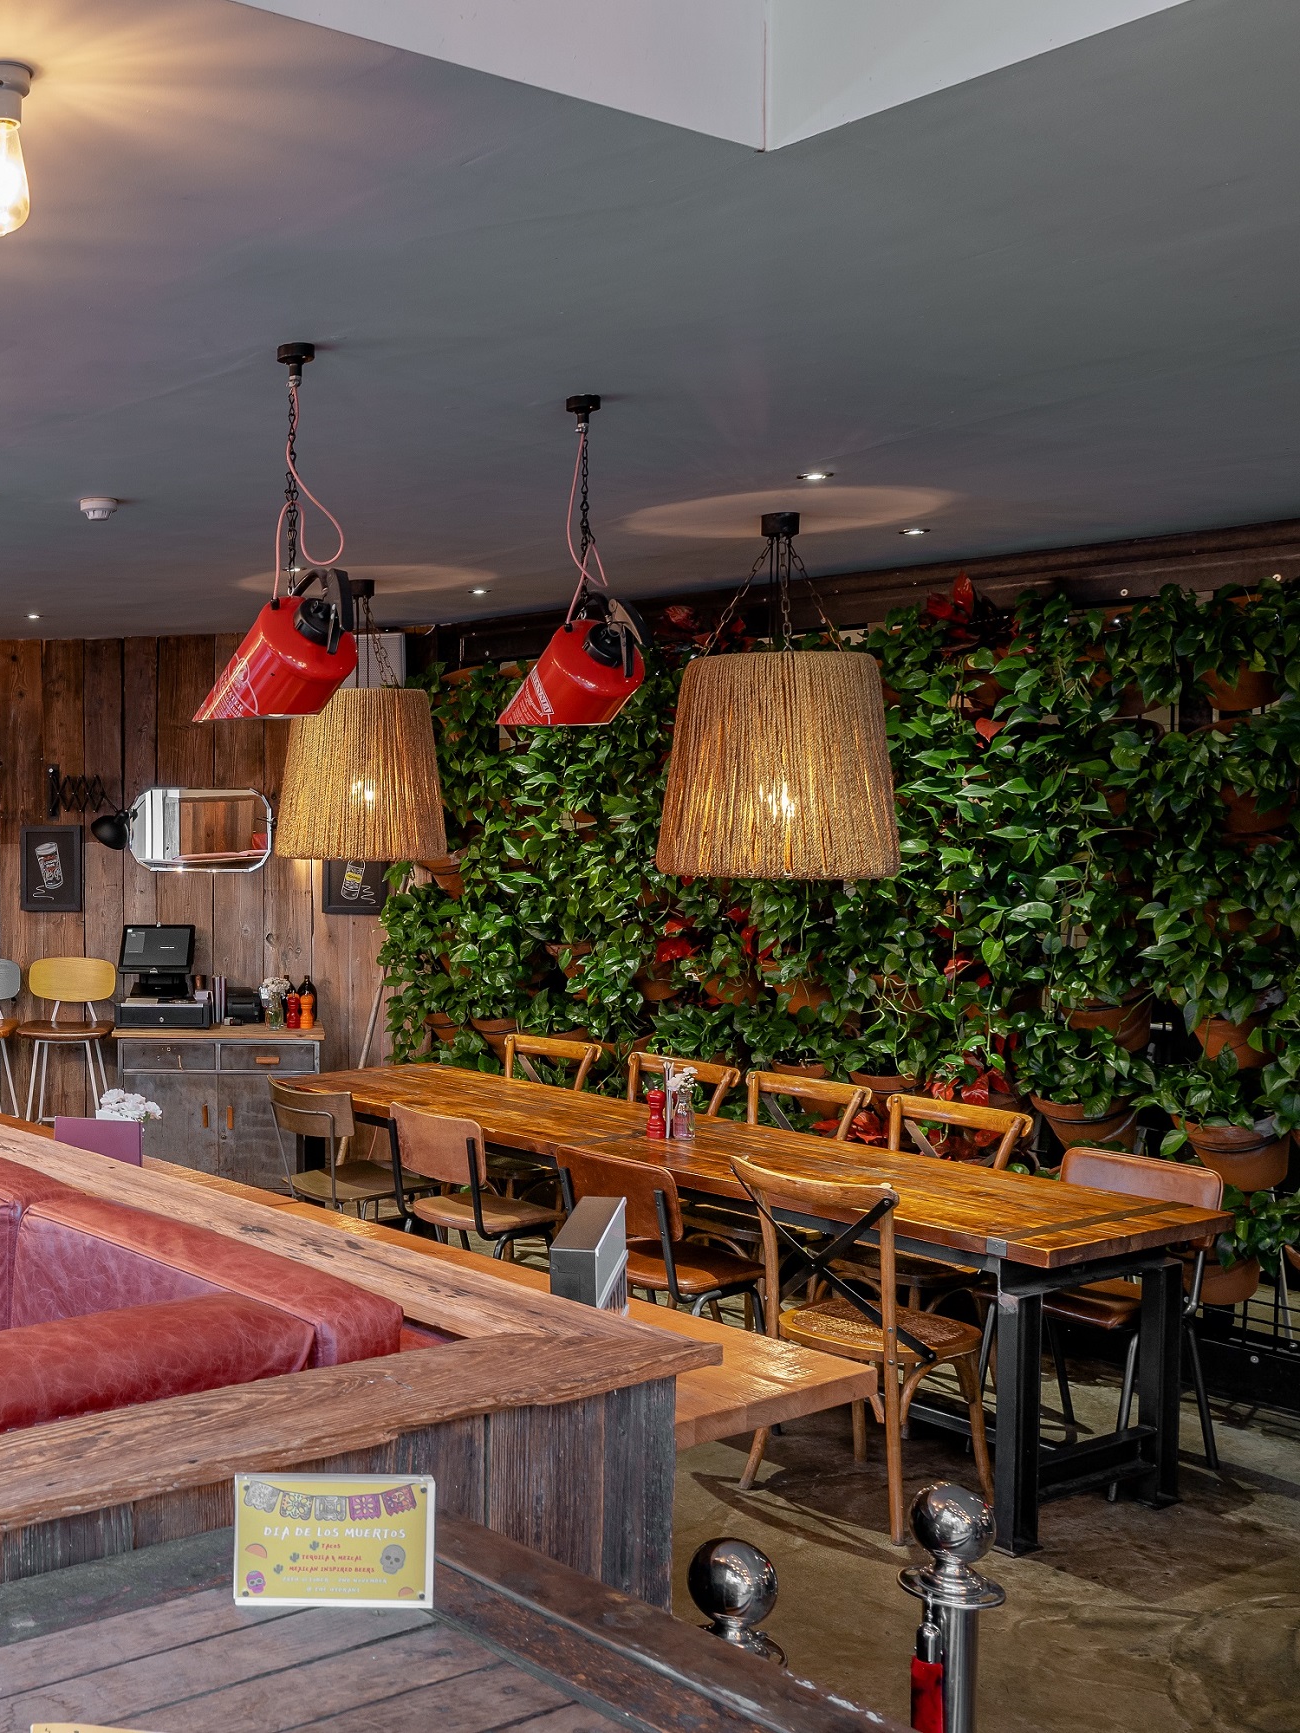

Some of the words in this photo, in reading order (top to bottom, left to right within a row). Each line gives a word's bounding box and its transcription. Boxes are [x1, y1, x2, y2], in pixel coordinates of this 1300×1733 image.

[263, 1526, 290, 1541] DIA
[295, 1526, 312, 1537] DE
[354, 1566, 375, 1574] BEERS
